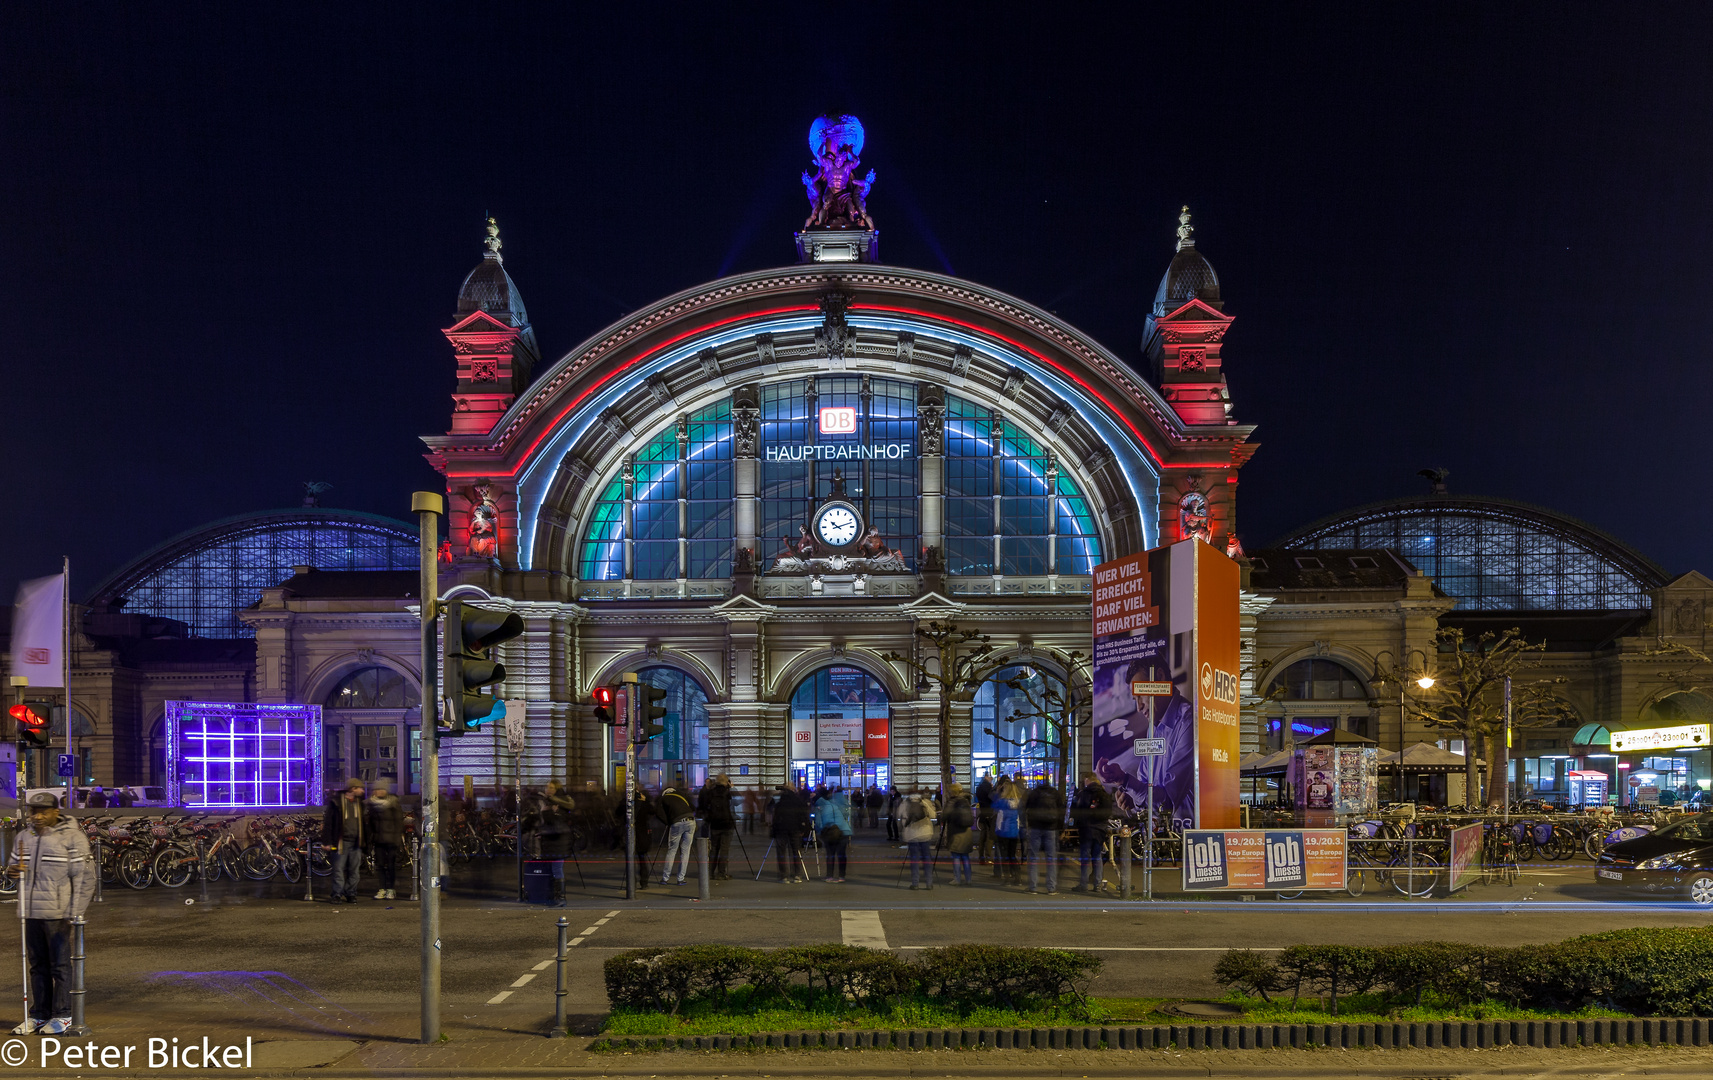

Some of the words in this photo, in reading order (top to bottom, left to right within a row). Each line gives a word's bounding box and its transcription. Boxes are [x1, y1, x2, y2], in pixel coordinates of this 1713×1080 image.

[825, 412, 851, 428] DB
[766, 444, 910, 460] HAUPTBAHNHOF
[1096, 568, 1117, 584] WER
[1120, 562, 1140, 578] VIEL
[1096, 578, 1144, 602] ERREICHT,
[1096, 600, 1121, 618] DARF
[1124, 595, 1145, 612] VIEL
[1096, 612, 1152, 635] ERWARTEN:
[1114, 638, 1133, 647] Business
[1119, 645, 1139, 653] Ersparnis
[1121, 652, 1144, 660] unterwegs
[1214, 669, 1237, 704] HRS
[1202, 706, 1211, 721] Das
[1212, 708, 1236, 727] Hotelportal
[60, 755, 68, 768] P
[1213, 748, 1228, 762] HRS.de
[1227, 838, 1266, 846] 19./20.3.
[1188, 836, 1222, 883] job
[1266, 836, 1300, 882] job
[1196, 866, 1222, 877] messe
[1275, 866, 1300, 876] messe
